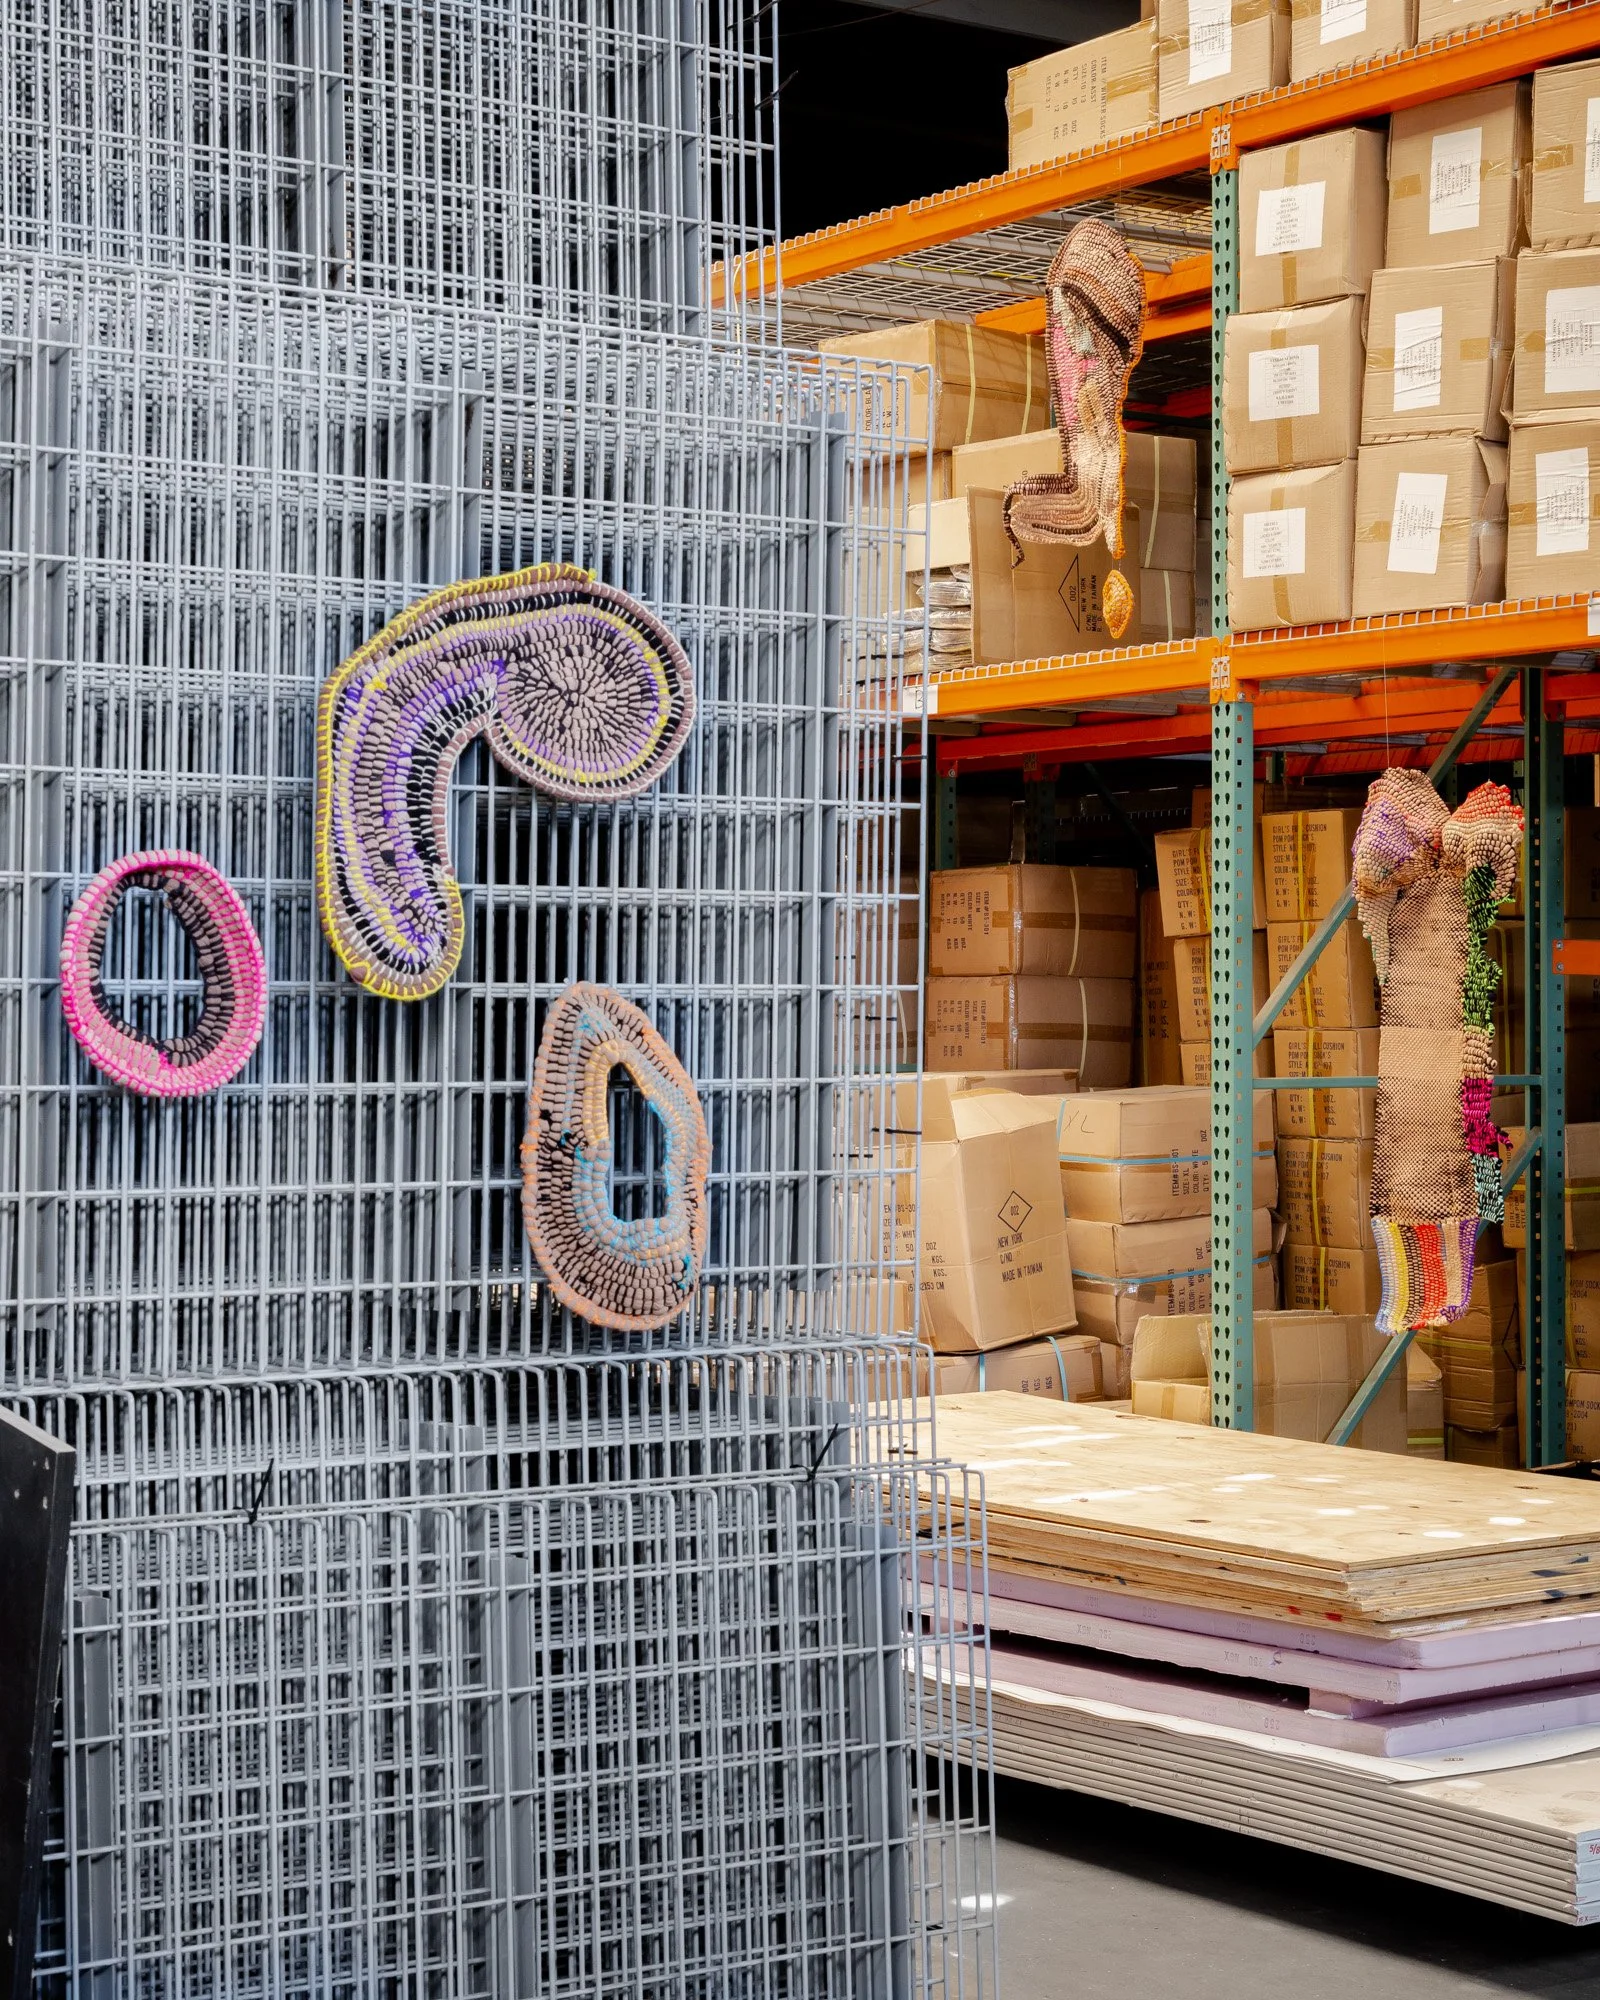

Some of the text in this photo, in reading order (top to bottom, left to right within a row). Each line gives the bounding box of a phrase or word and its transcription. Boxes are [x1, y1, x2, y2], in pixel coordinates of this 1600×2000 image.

[1306, 824, 1327, 832] CUSHION
[1323, 1042, 1344, 1050] CUSHION
[1321, 1153, 1342, 1161] CUSHION
[1183, 1168, 1189, 1177] XL
[1010, 1206, 1019, 1216] 002
[998, 1232, 1023, 1248] NEW YORK
[926, 1242, 936, 1250] DOZ
[1329, 1259, 1350, 1269] CUSHION
[1002, 1262, 1043, 1282] MADE IN TAIWAN
